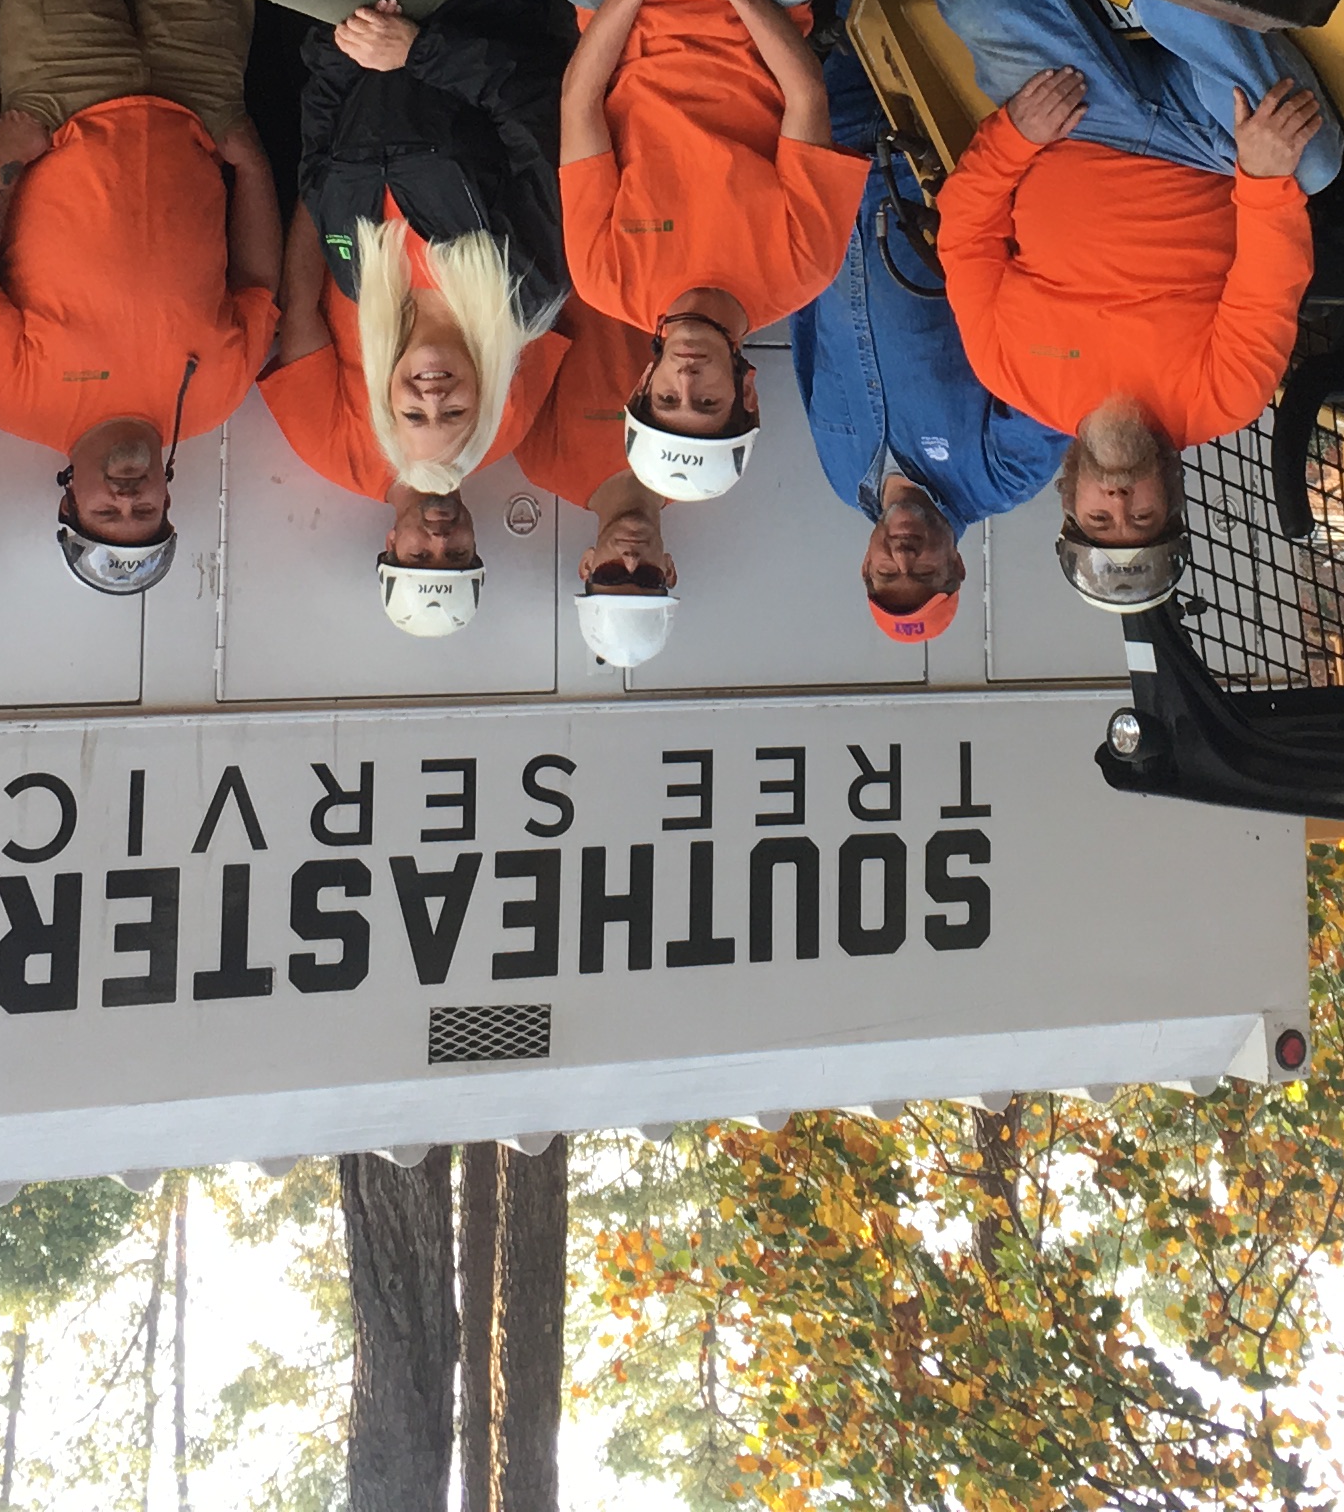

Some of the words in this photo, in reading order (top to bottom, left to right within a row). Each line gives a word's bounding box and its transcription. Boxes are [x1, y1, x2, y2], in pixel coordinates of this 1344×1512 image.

[660, 449, 704, 466] KASK
[417, 584, 453, 594] KASK
[661, 741, 992, 830] TREE
